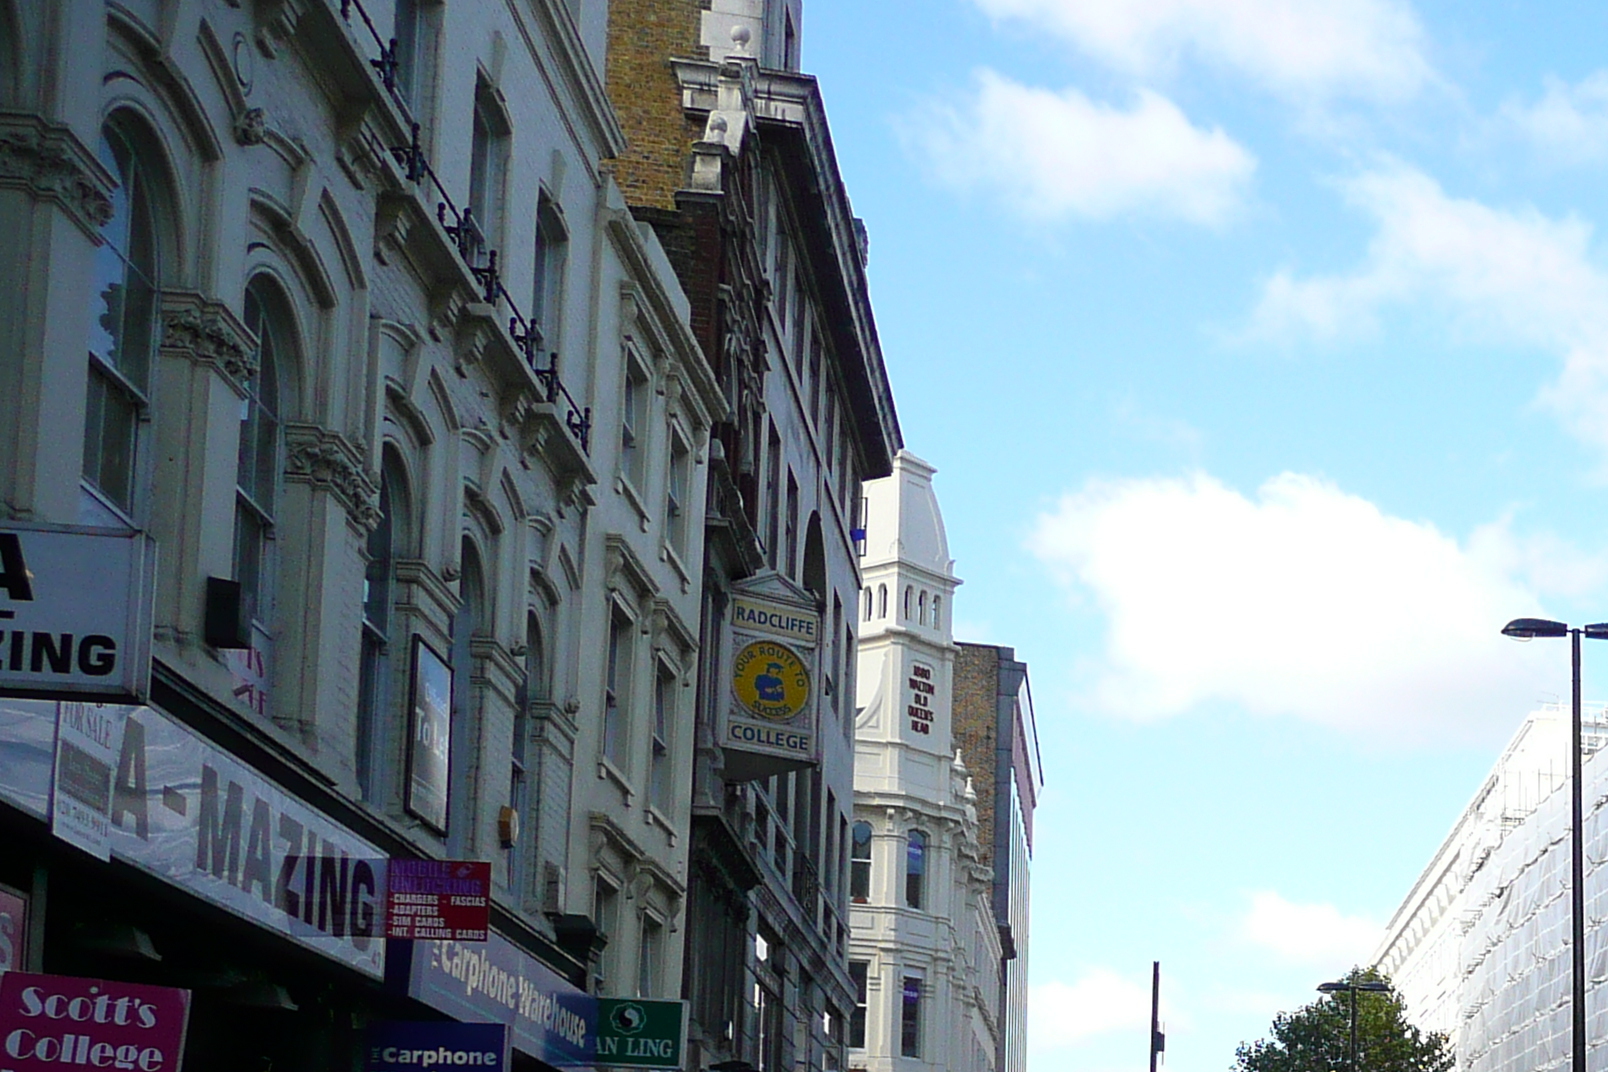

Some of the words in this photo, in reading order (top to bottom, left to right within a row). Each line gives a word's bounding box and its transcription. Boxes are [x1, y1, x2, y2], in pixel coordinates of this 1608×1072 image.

[735, 605, 815, 636] RADCLIFFE
[733, 648, 756, 680] YOUR
[759, 645, 797, 669] ROUTE
[792, 668, 807, 689] TO
[908, 677, 935, 696] WALTON
[751, 700, 792, 718] SUCCESS
[914, 692, 928, 707] OLD
[907, 704, 934, 723] QUEEN'S
[86, 711, 113, 750] SALE
[911, 719, 930, 735] HEAD
[730, 724, 809, 751] COLLEGE
[390, 860, 451, 877] MOBILE
[390, 878, 483, 895] UNLOCKING
[450, 896, 487, 908] FASCIAS
[415, 917, 446, 928] CARDS
[414, 928, 452, 940] CALLING
[455, 929, 486, 941] CARDS
[441, 939, 517, 1010] Carphone
[518, 975, 588, 1049] Warehouse
[18, 985, 158, 1029] Scott's
[5, 1028, 165, 1072] College
[625, 1036, 674, 1059] LING
[382, 1046, 498, 1069] Carphone
